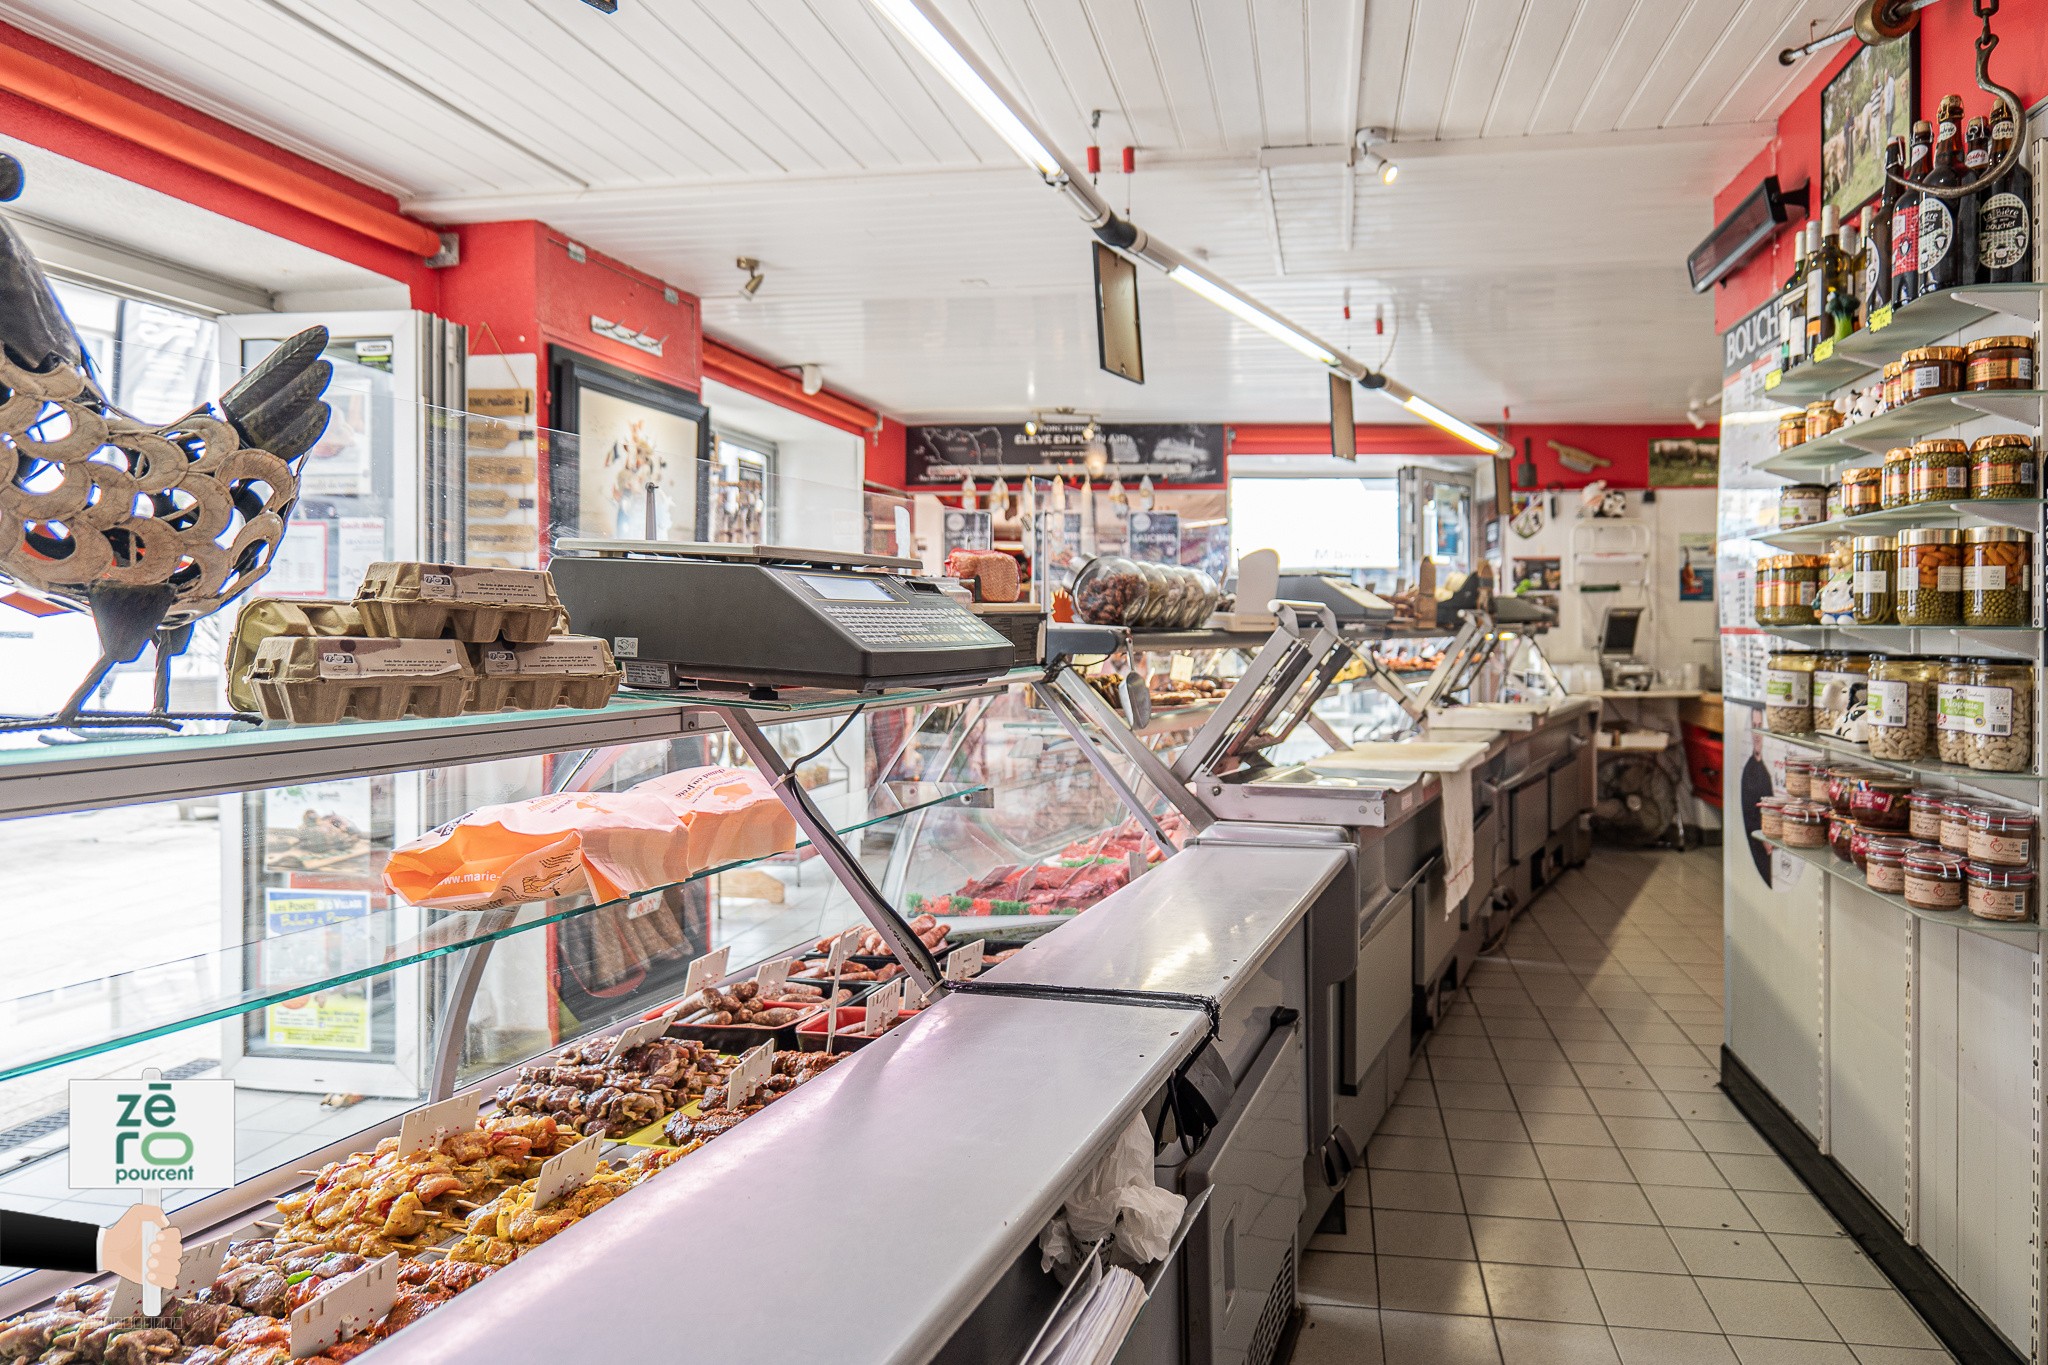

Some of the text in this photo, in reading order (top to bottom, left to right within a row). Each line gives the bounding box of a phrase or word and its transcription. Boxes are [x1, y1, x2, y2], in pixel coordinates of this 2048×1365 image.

[1726, 297, 1783, 369] BOUCH
[1053, 433, 1071, 445] EN
[1071, 433, 1107, 445] PLIN
